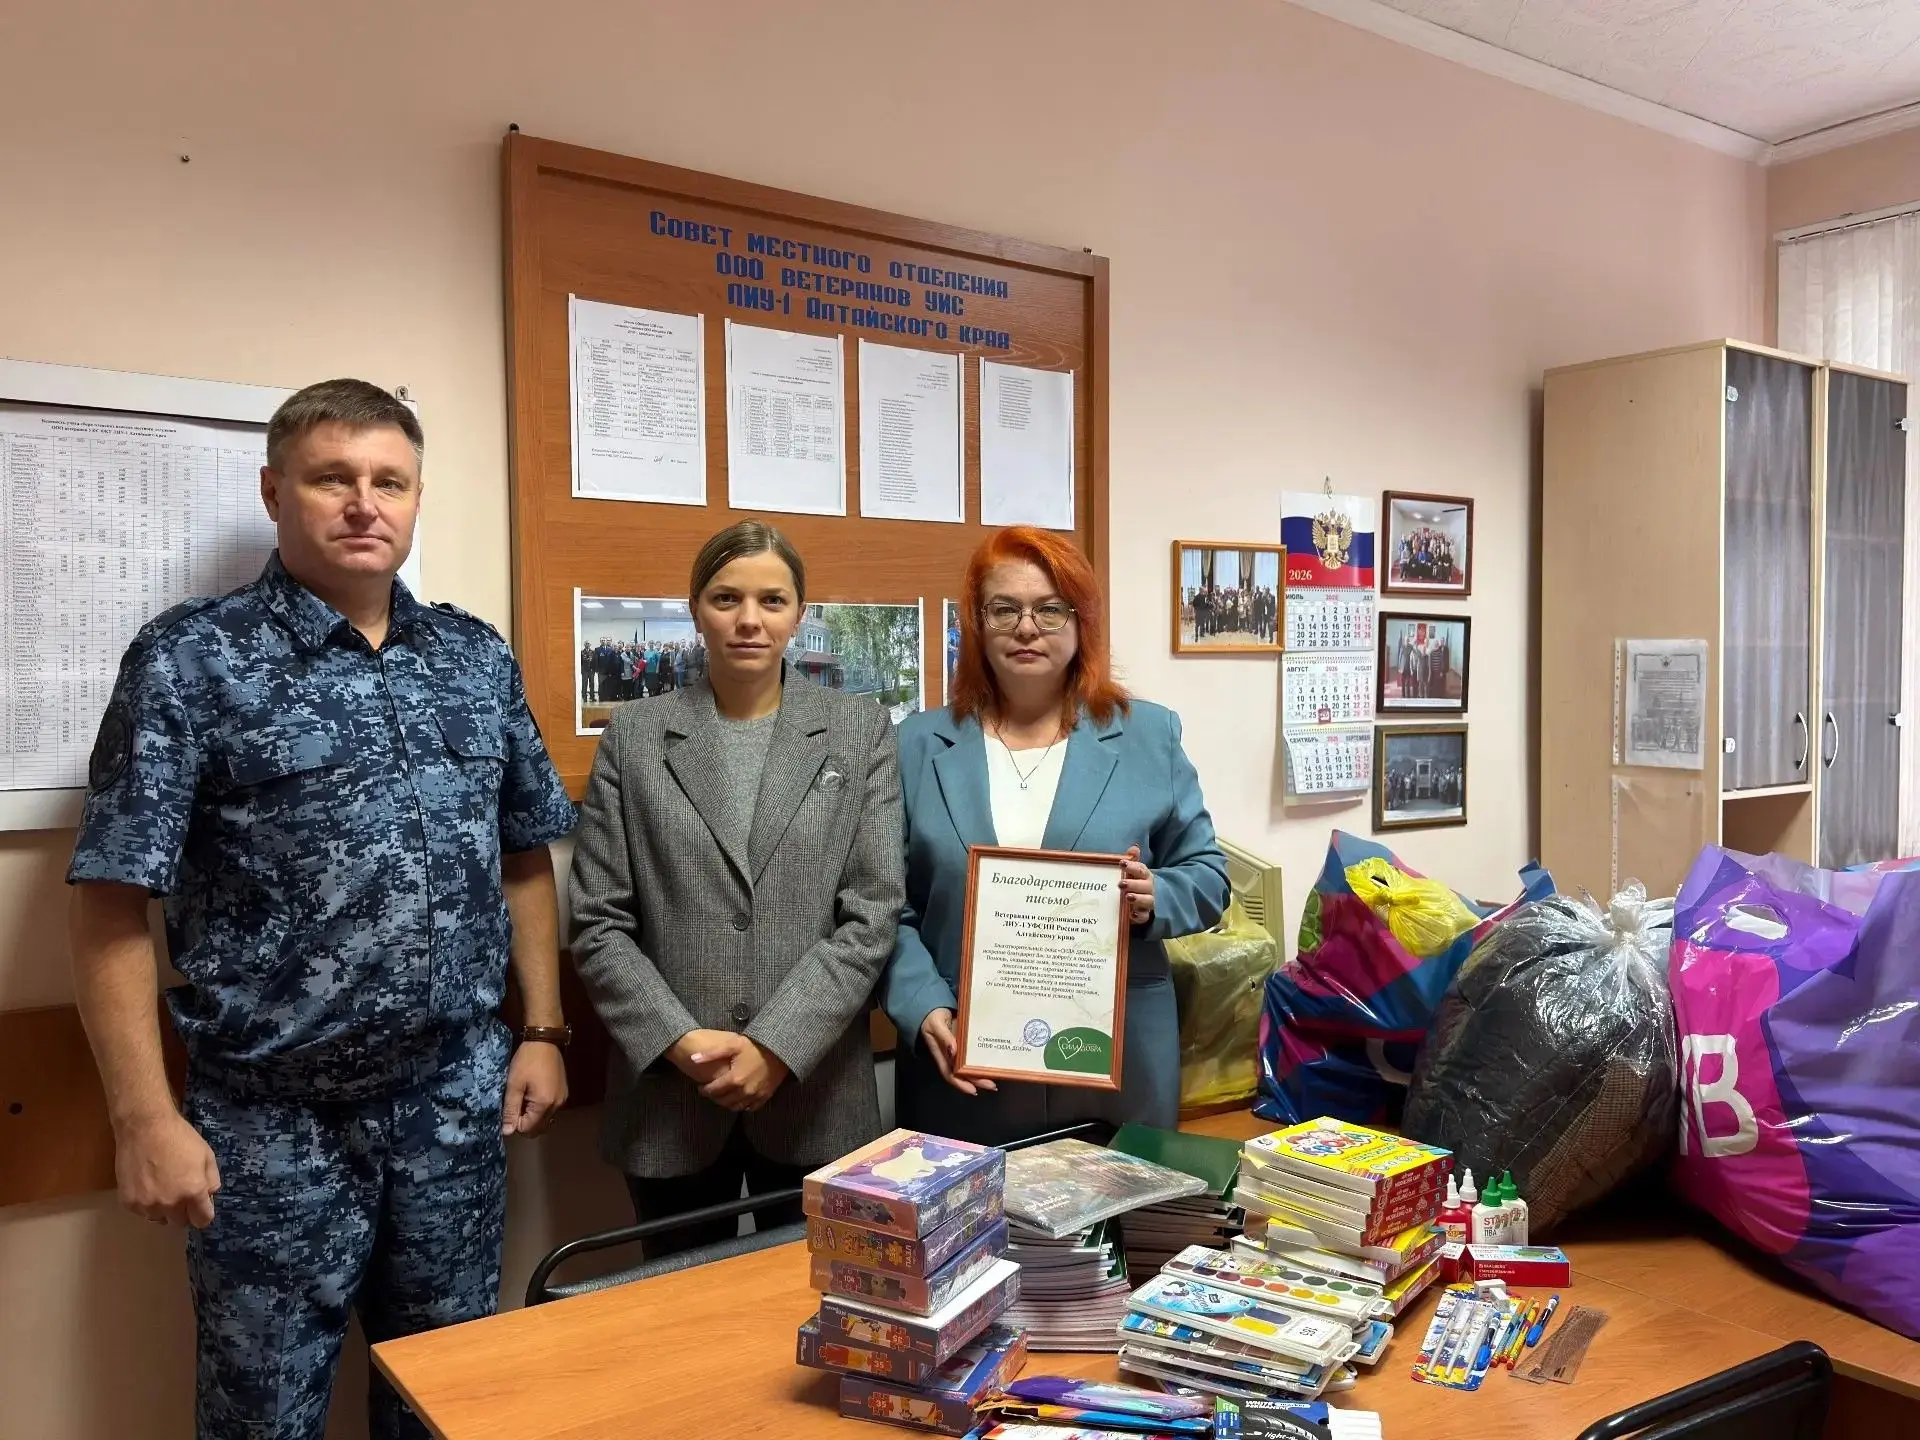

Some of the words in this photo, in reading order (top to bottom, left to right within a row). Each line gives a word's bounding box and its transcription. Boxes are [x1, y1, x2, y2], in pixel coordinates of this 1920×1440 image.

[716, 252, 764, 280] ООО
[925, 290, 964, 316] УИС
[727, 283, 790, 315] ЛИУ-1
[1288, 569, 1312, 581] 2026
[1322, 606, 1326, 614] 1
[1333, 606, 1338, 614] 2
[1345, 606, 1349, 614] 3
[991, 872, 1108, 892] Благодарственное
[1026, 894, 1070, 906] письмо
[994, 911, 1030, 921] Ветеранам
[1037, 915, 1080, 924] сотрудникам
[1081, 917, 1099, 925] ФКУ
[1027, 922, 1055, 930] УФСИН
[1015, 931, 1056, 941] Алтайскому
[1057, 933, 1076, 942] краю
[1484, 1229, 1497, 1237] ПВА
[873, 1360, 884, 1369] 35
[875, 1399, 887, 1408] 35
